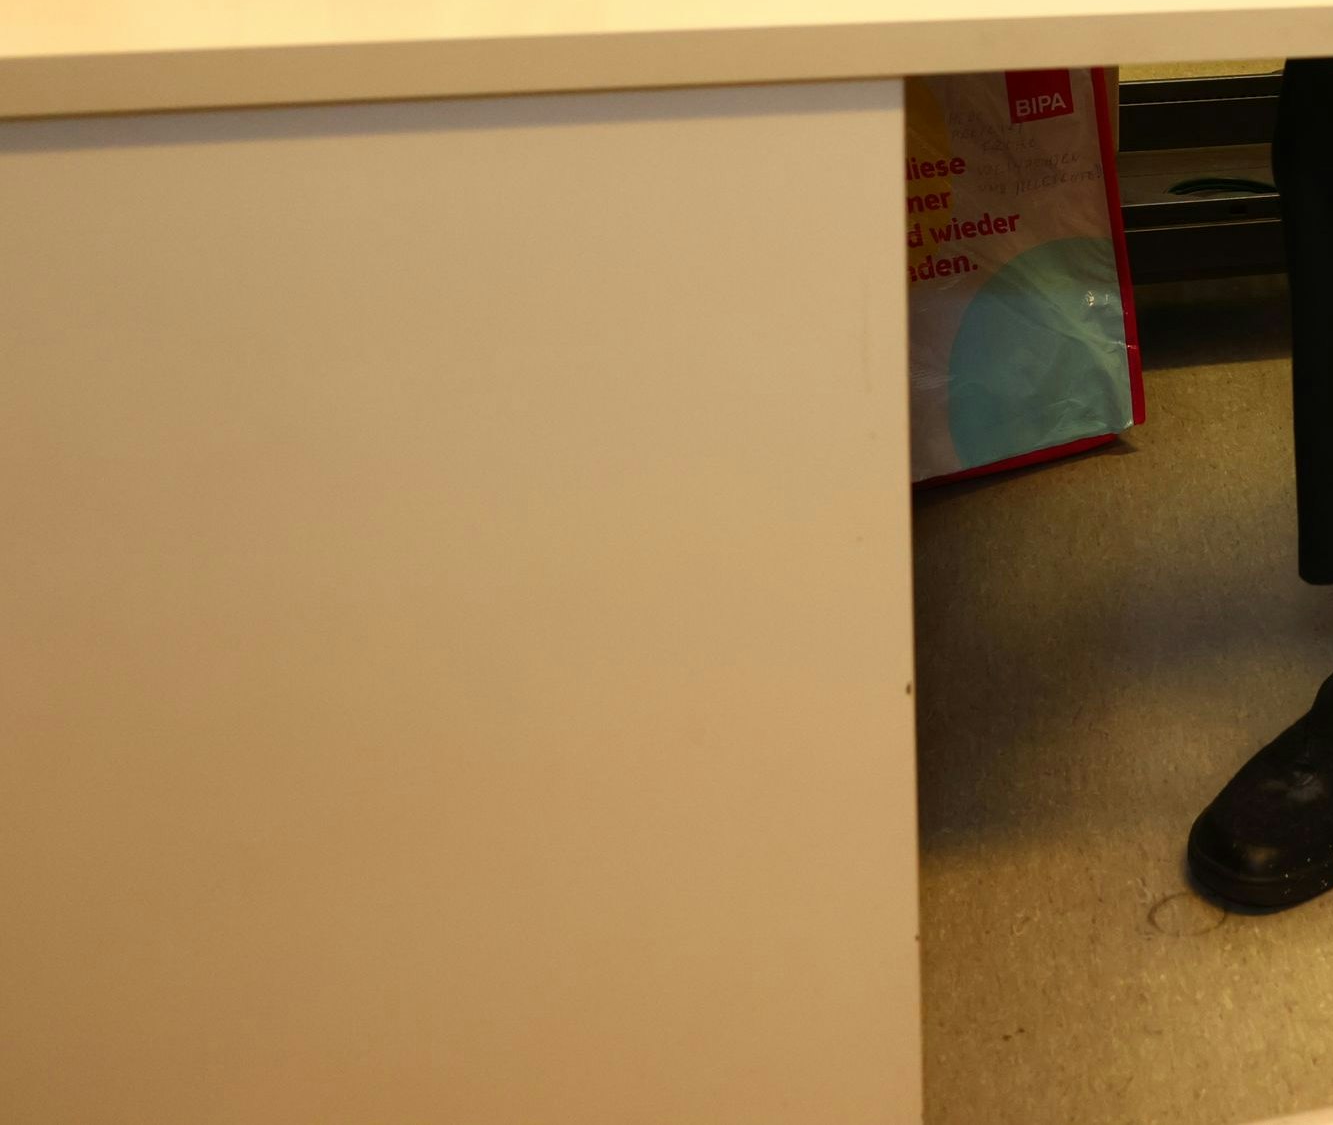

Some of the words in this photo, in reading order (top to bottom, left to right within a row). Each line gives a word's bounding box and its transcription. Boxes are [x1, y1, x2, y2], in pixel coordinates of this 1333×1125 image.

[1015, 92, 1066, 117] BIPA
[907, 222, 924, 248] d
[929, 213, 1020, 244] wieder
